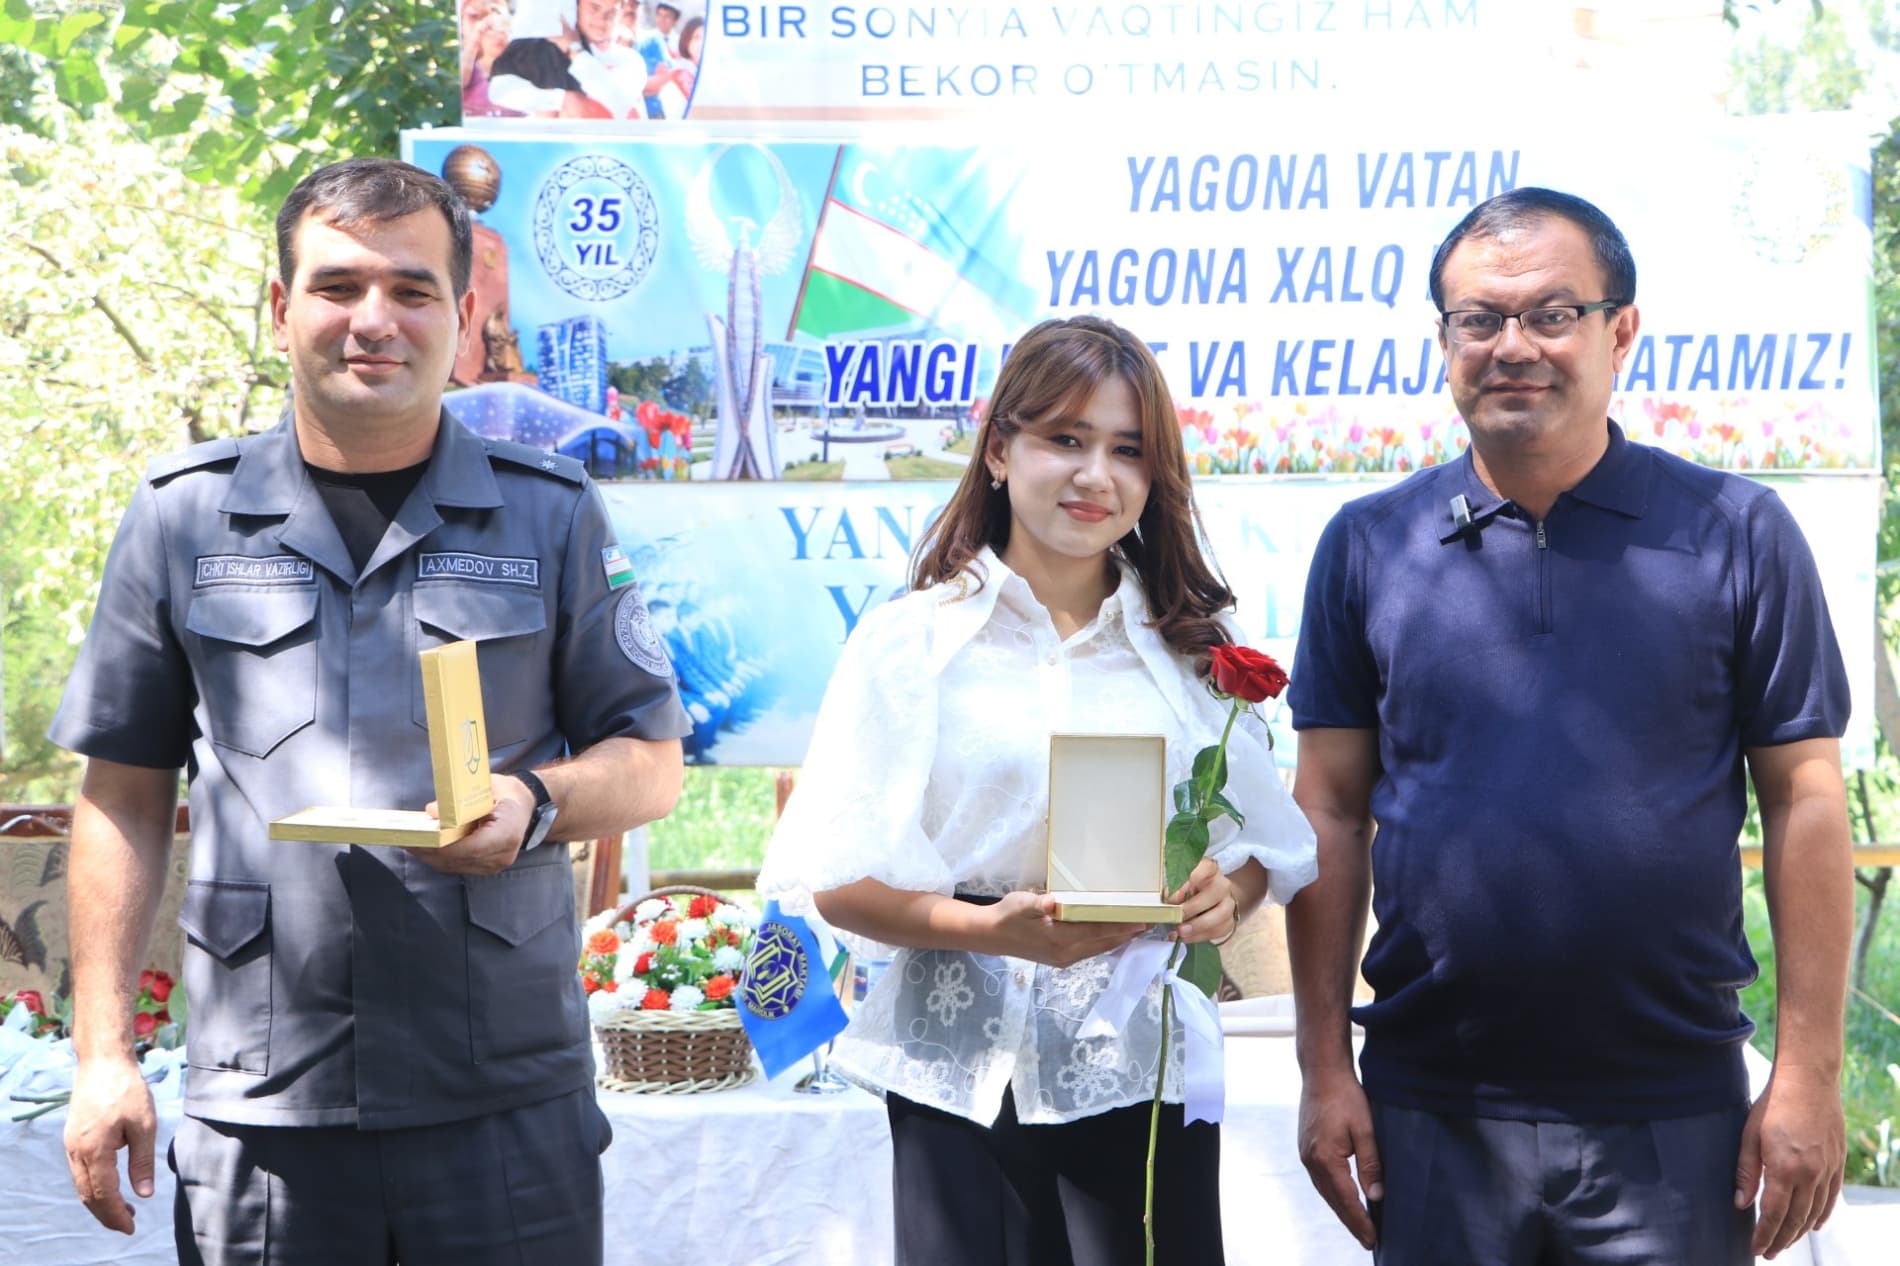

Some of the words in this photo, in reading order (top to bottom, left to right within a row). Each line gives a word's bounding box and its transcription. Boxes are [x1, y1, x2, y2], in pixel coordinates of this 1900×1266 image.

[722, 4, 807, 39] BIR
[830, 4, 1028, 39] SONYIA
[1052, 1, 1337, 38] VAQTINGIZ
[1364, 0, 1478, 31] HAM
[861, 63, 1039, 97] BEKOR
[1127, 153, 1328, 212] YAGONA
[1357, 149, 1521, 209] VATAN
[570, 198, 622, 232] 35
[576, 244, 619, 266] YIL
[1046, 247, 1247, 307] YAGONA
[1269, 243, 1404, 309] XALQ
[825, 343, 977, 403] YANGI
[1189, 340, 1247, 397] VA
[1613, 332, 1852, 393] ATAMIZ!
[226, 561, 262, 578] ISHLAR
[426, 557, 494, 576] AXMEDOV
